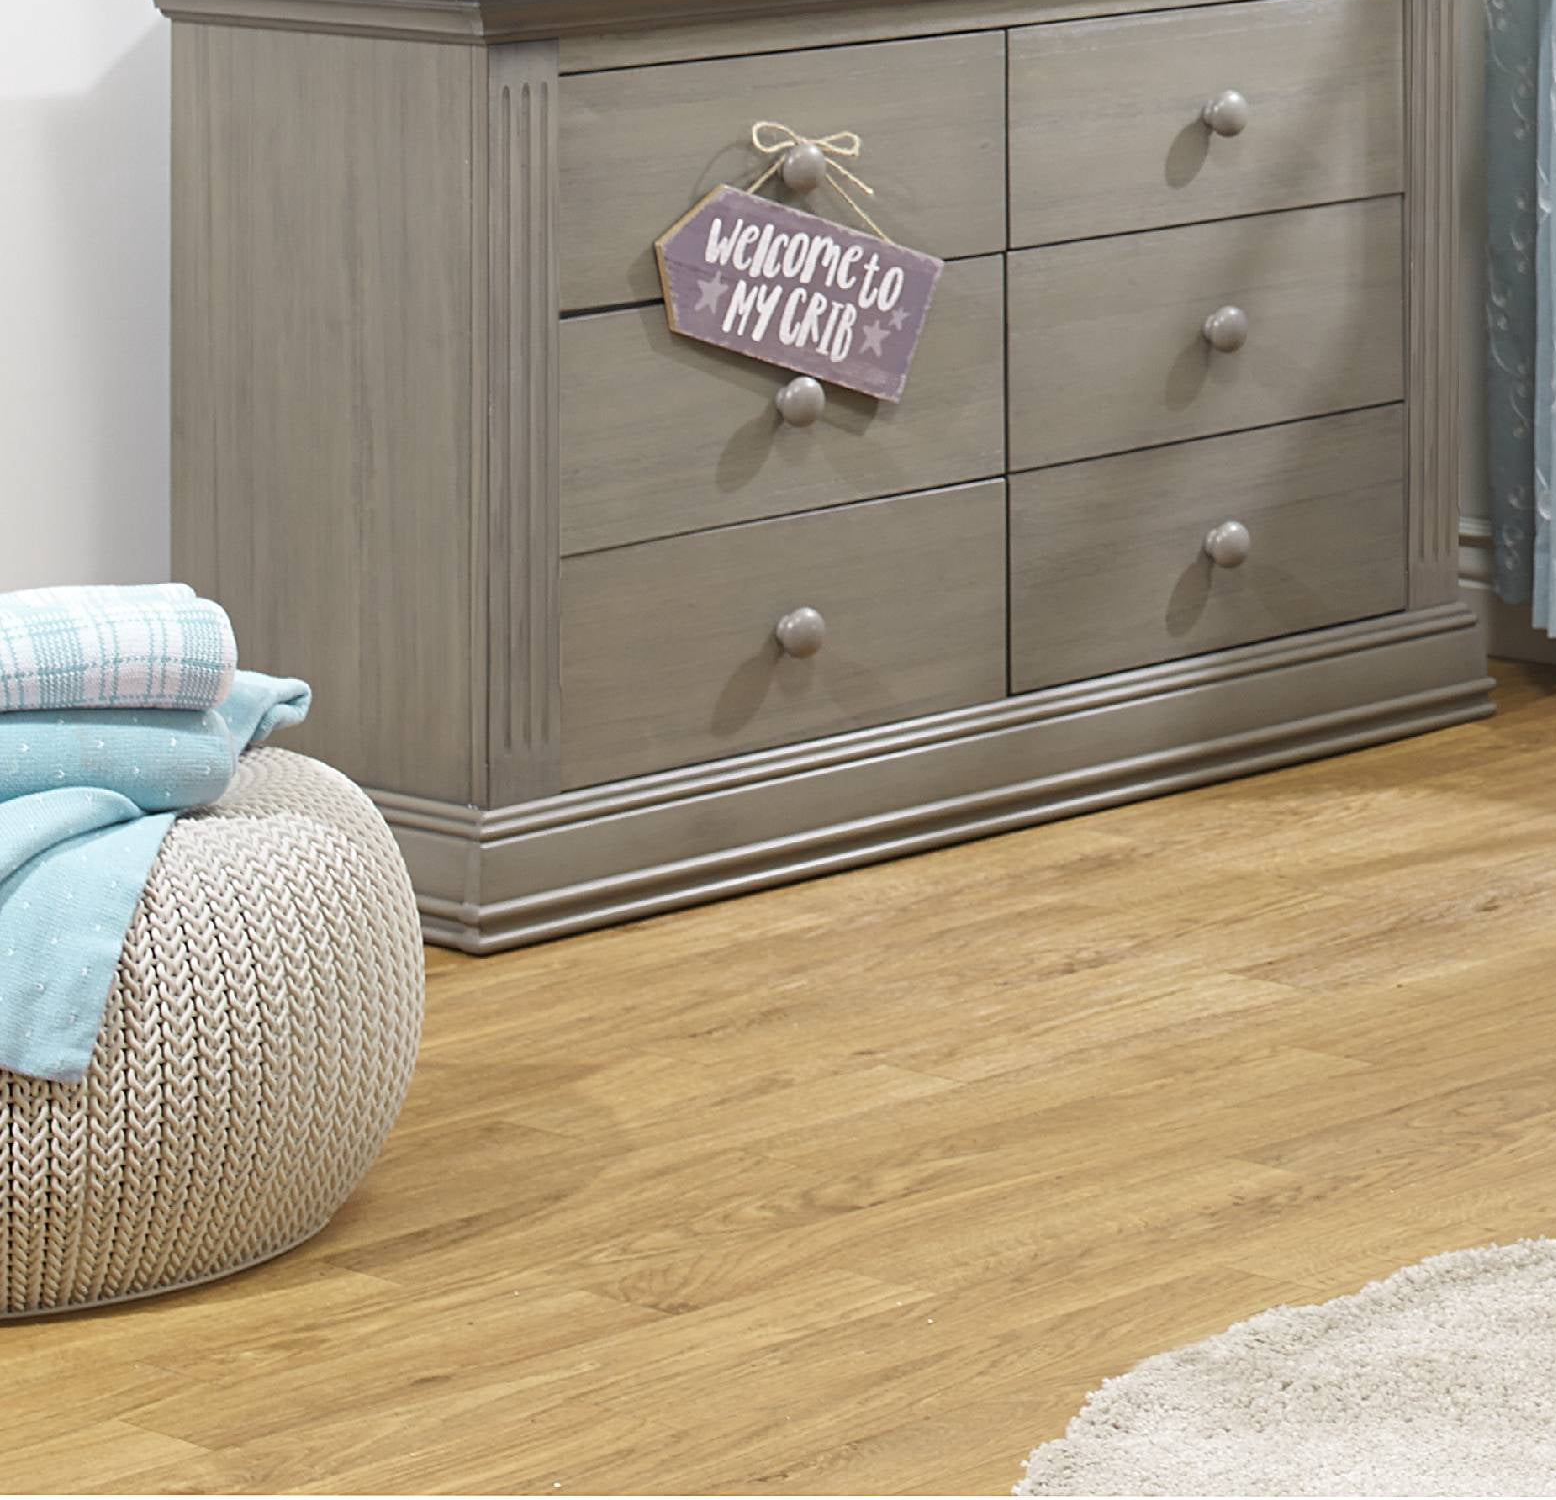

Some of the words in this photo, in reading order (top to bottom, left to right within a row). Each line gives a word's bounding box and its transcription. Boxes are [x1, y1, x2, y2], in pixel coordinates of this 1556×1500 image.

[857, 252, 904, 311] to
[722, 280, 783, 343] MY
[778, 287, 858, 363] CRIB
